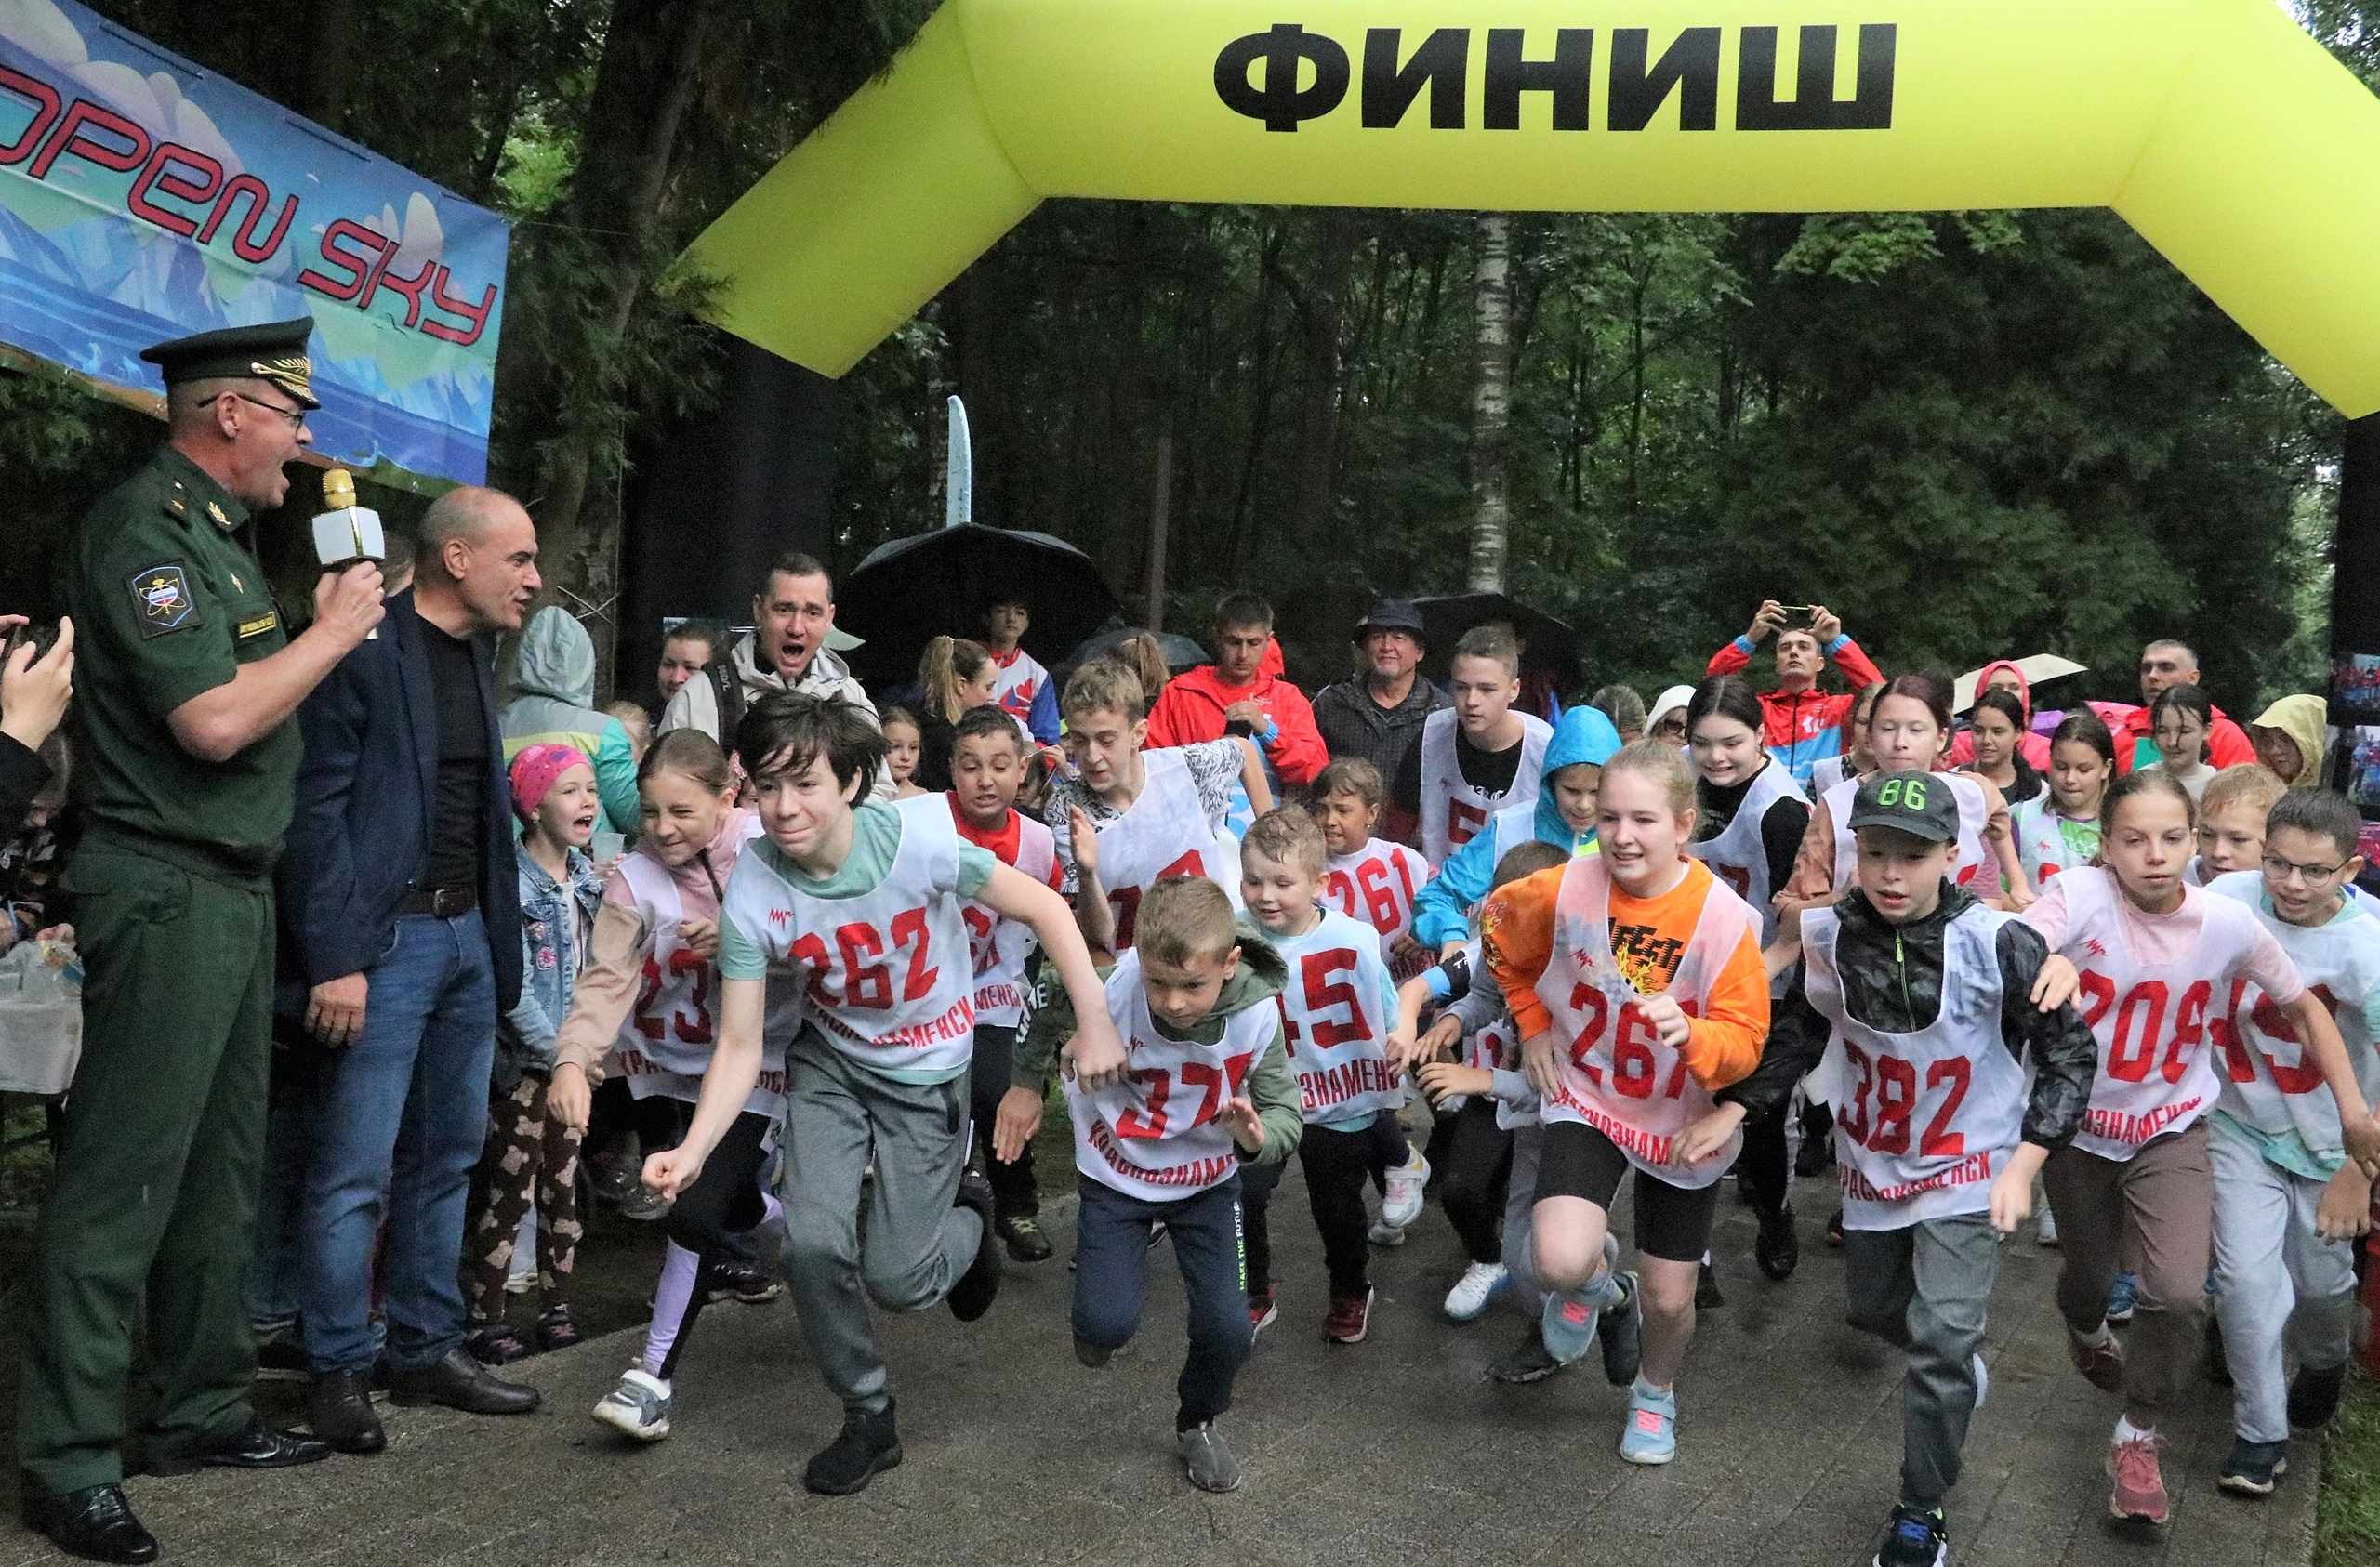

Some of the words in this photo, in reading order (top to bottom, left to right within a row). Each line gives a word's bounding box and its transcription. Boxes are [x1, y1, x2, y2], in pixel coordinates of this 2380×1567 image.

[1213, 23, 1897, 133] ФИНИШ
[1877, 778, 1927, 810] 86
[1327, 848, 1415, 936] 261
[788, 907, 939, 1010] 262
[1608, 916, 1684, 969] FEST
[1837, 1037, 1972, 1157] 382
